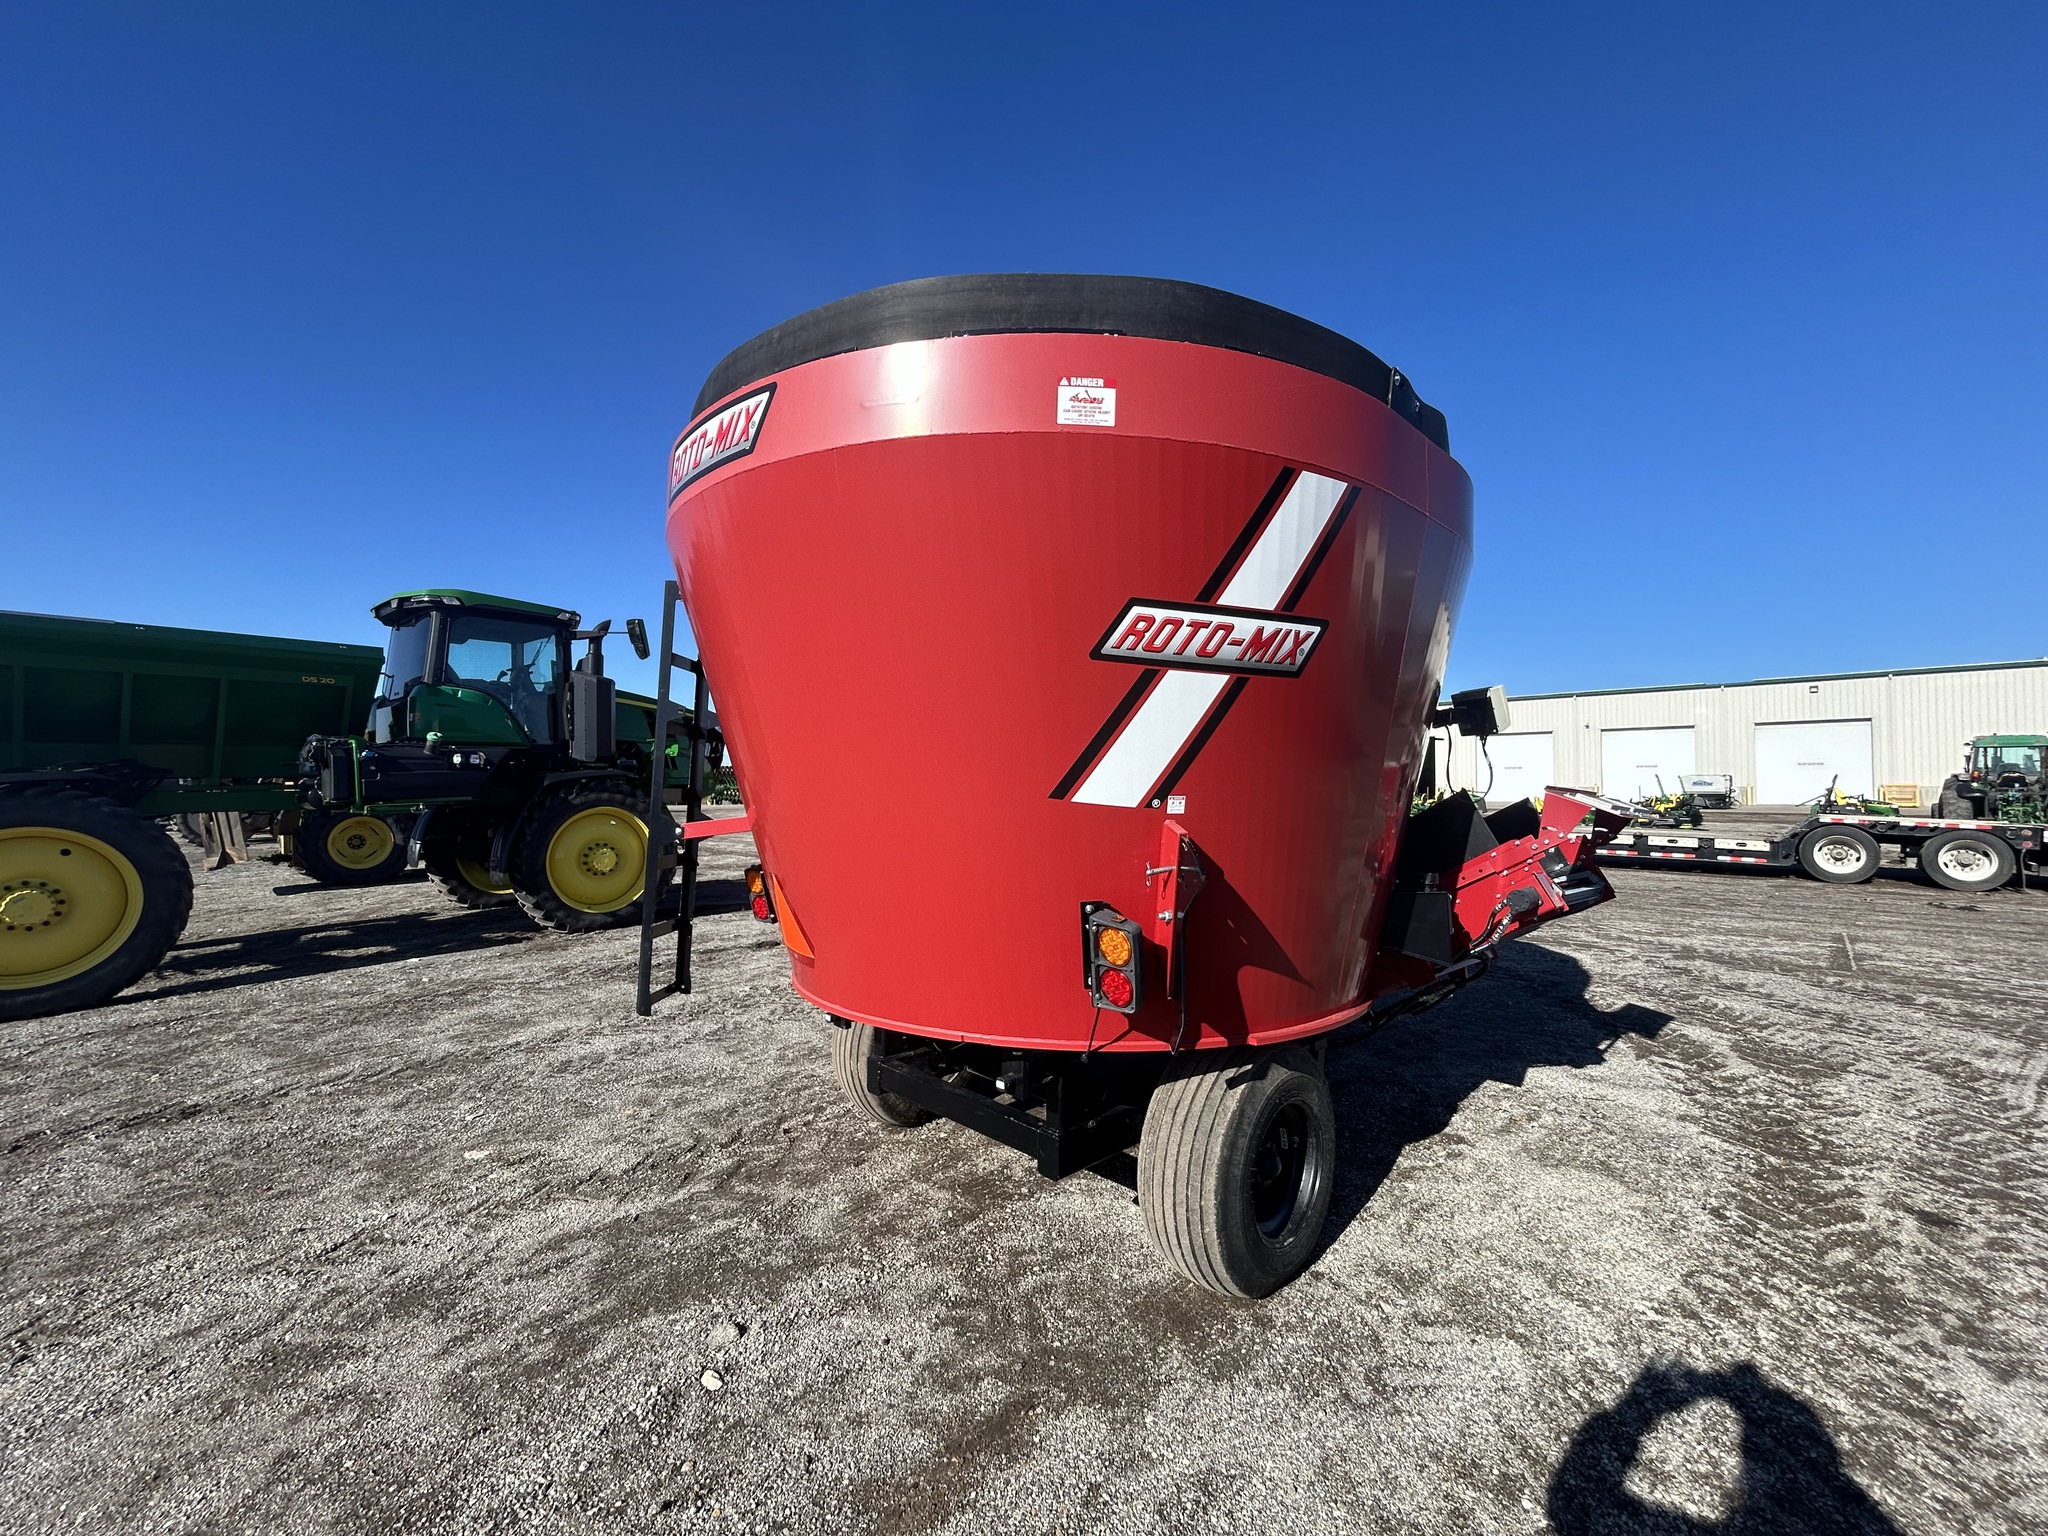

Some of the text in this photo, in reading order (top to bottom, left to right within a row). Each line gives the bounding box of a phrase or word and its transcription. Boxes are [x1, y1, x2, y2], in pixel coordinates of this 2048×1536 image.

[1070, 376, 1104, 387] DANGER
[670, 399, 764, 488] ROTO-MIX
[1111, 613, 1315, 666] ROTO-MIX
[301, 675, 318, 683] DS
